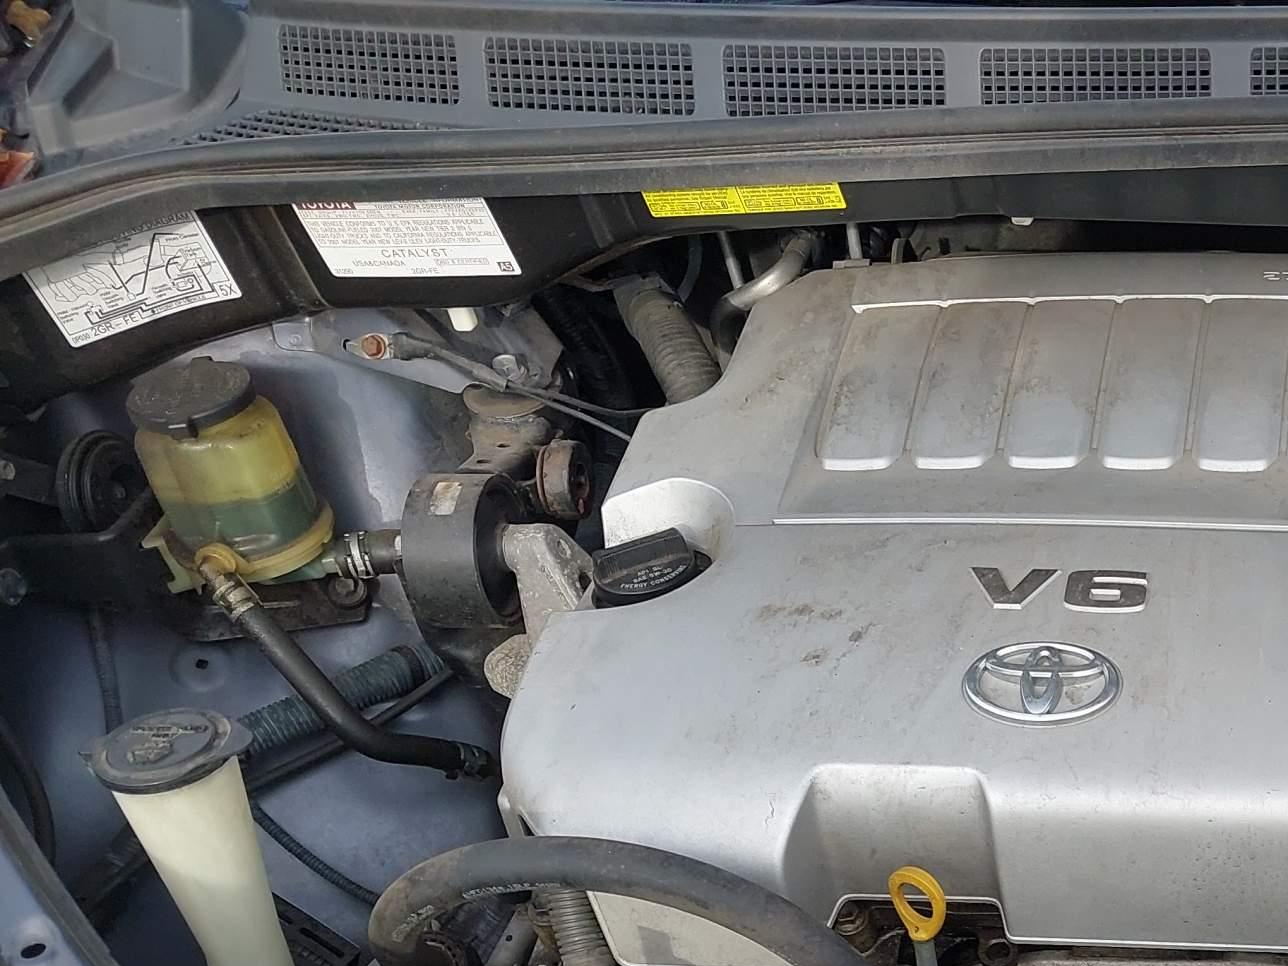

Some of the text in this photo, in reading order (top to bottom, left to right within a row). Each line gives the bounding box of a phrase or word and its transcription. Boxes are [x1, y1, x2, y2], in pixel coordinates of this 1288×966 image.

[381, 248, 449, 257] CATALYST
[220, 284, 237, 297] 5X
[650, 564, 687, 586] CONSERVING
[969, 567, 1147, 613] V6
